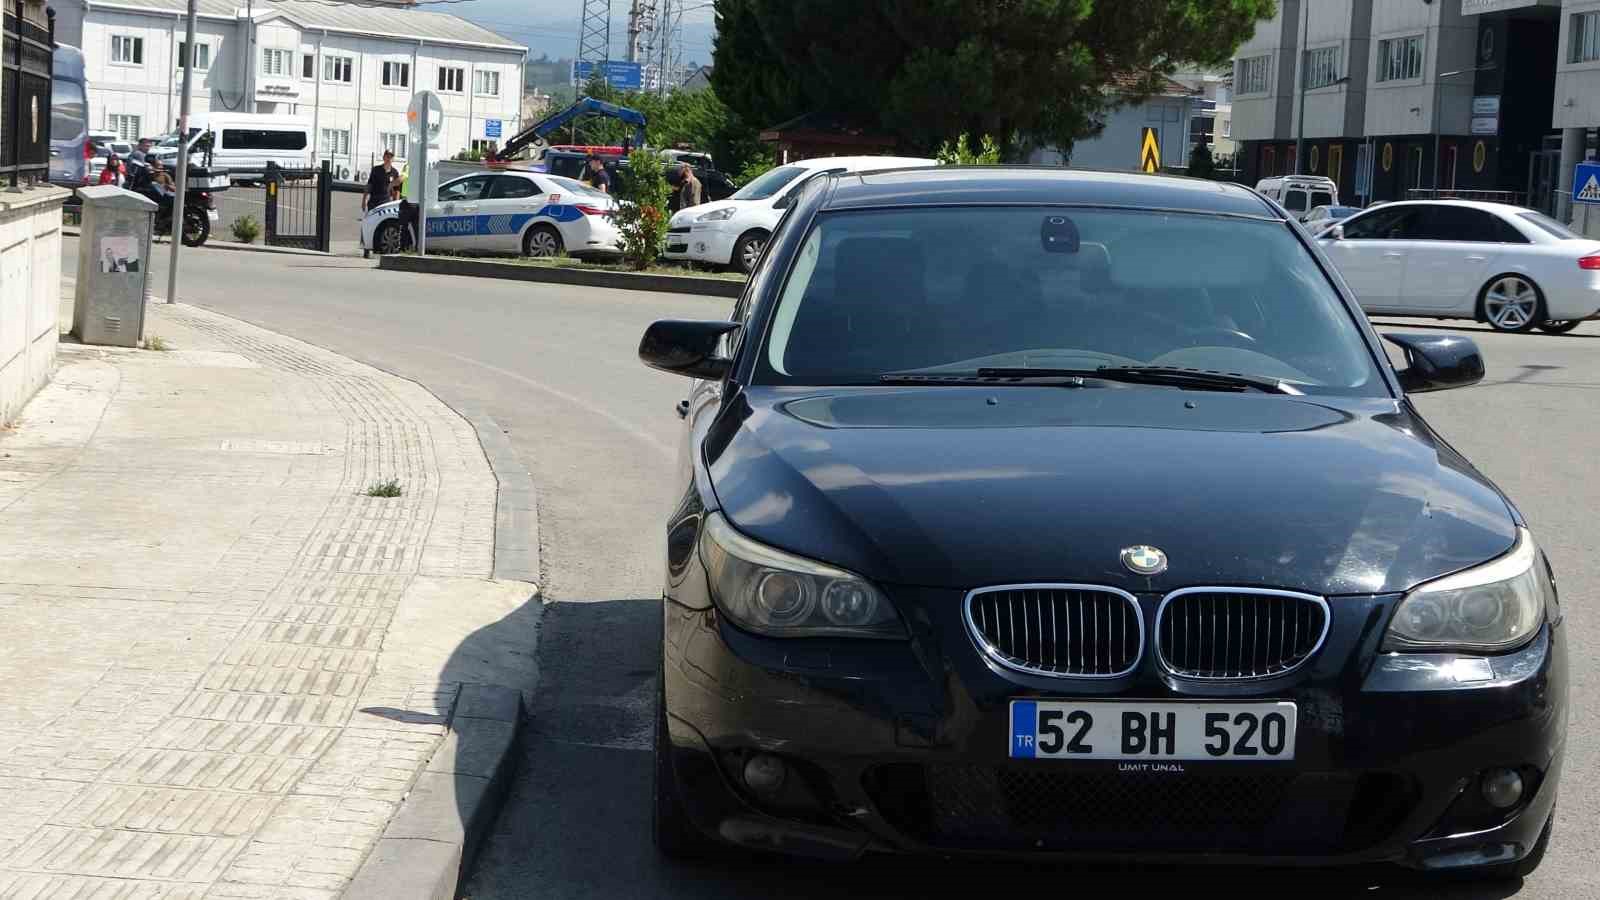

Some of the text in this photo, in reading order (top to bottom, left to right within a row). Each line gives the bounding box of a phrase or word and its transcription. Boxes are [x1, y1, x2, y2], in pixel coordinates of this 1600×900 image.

[1015, 710, 1286, 757] TR 52 BH 520
